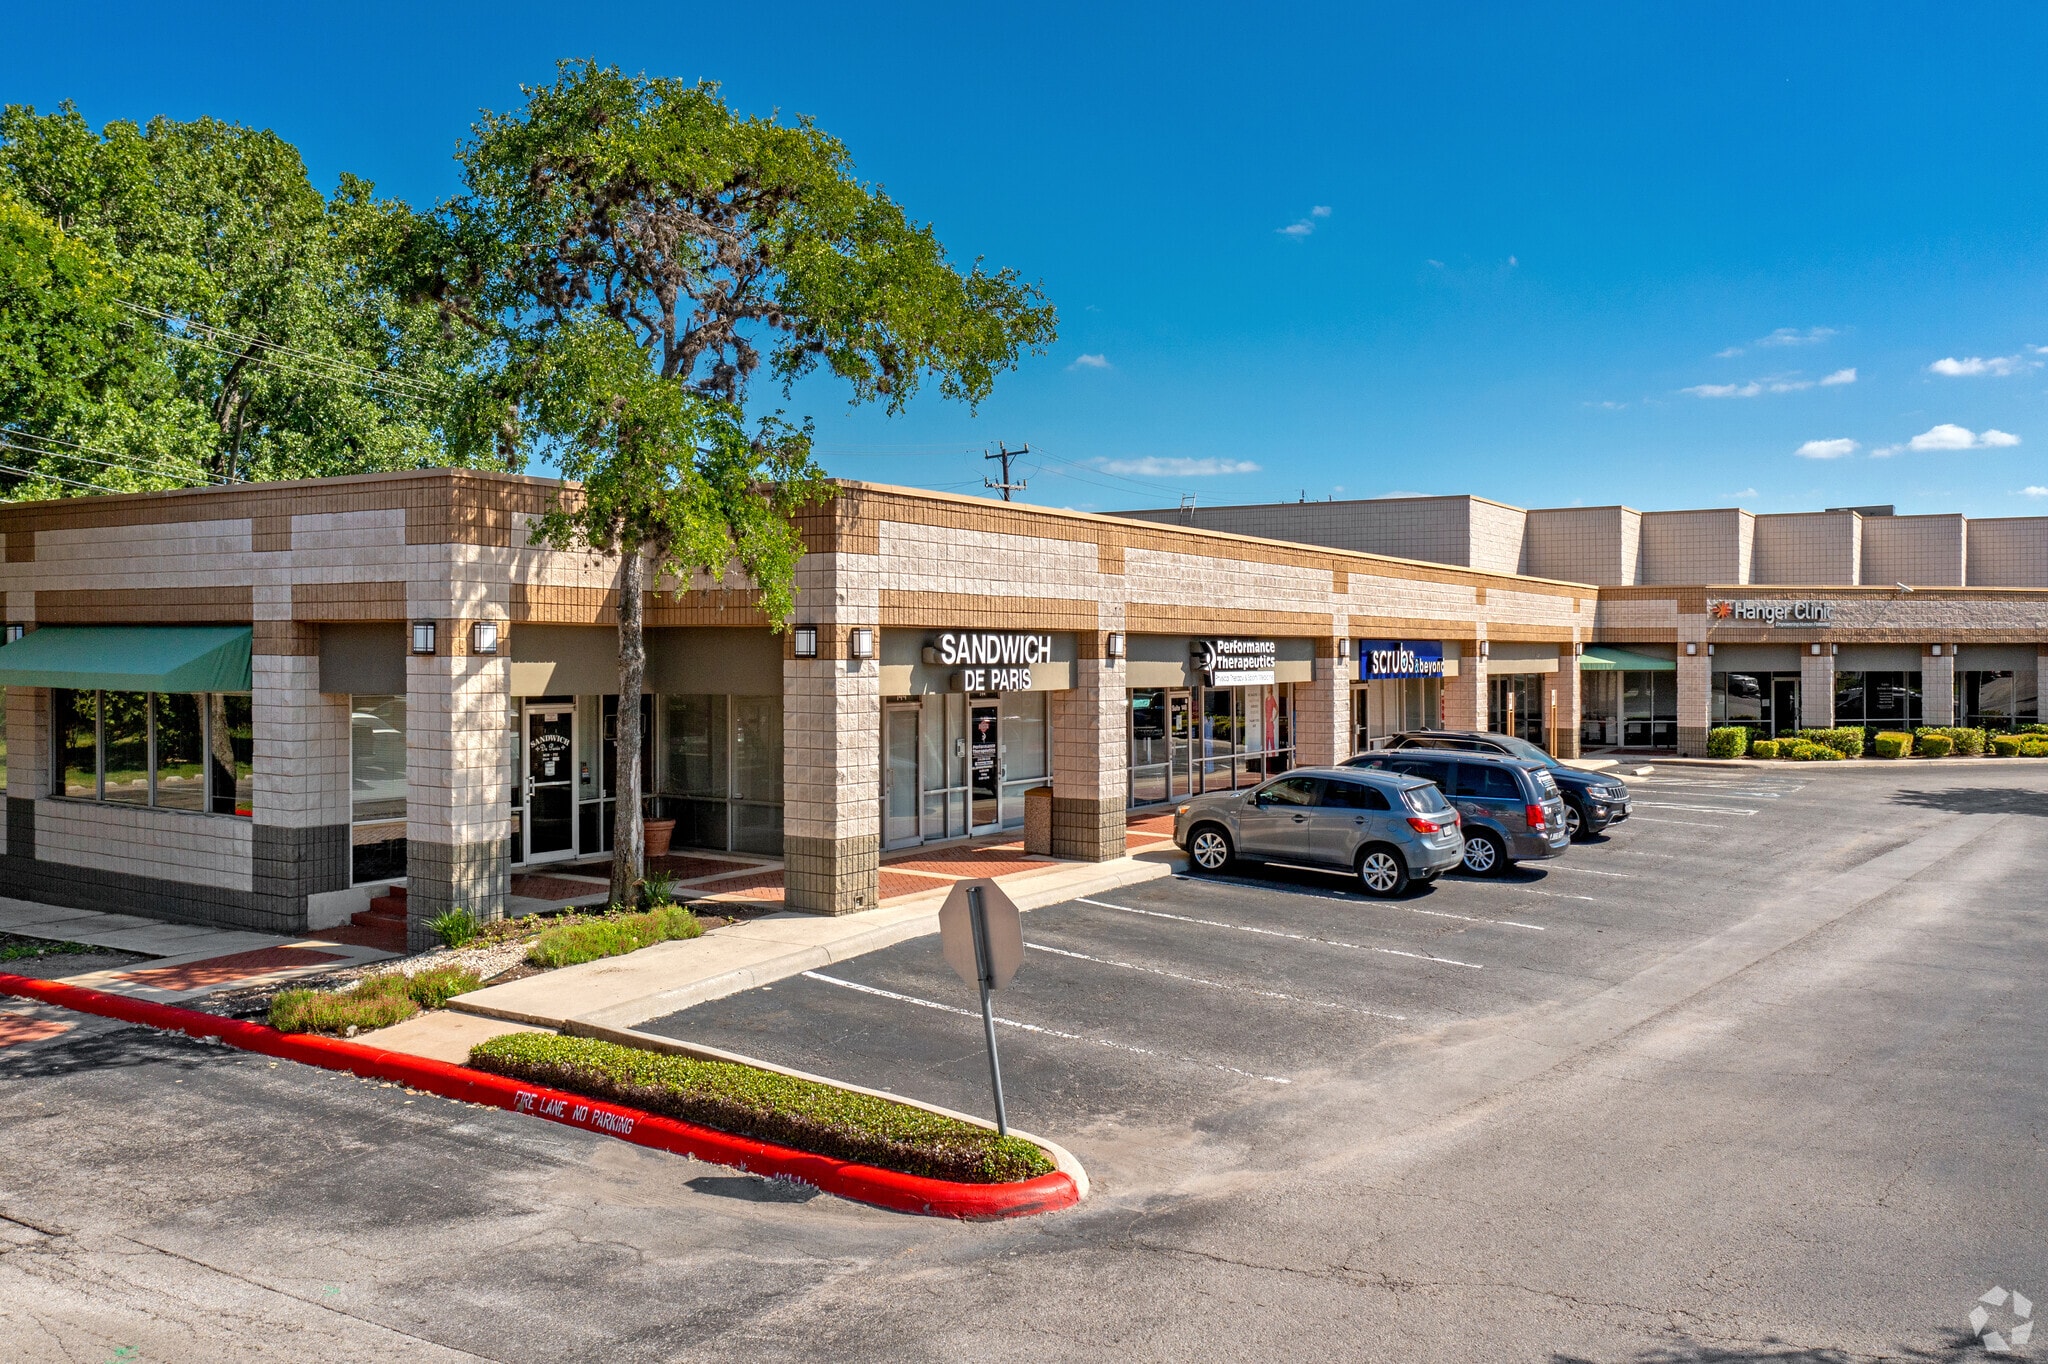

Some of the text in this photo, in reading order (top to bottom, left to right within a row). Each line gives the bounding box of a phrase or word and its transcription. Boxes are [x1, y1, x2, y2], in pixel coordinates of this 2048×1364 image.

[1735, 601, 1835, 623] Hanger Clinic
[941, 634, 1051, 665] SANDWICH
[1217, 640, 1275, 653] Performance
[1217, 655, 1275, 670] Therapeutics
[1372, 642, 1414, 674] scrubs
[965, 668, 1032, 691] DE PARIS
[530, 735, 570, 748] SANDWICH
[514, 1091, 634, 1134] FIRE LANE NO PARKING
